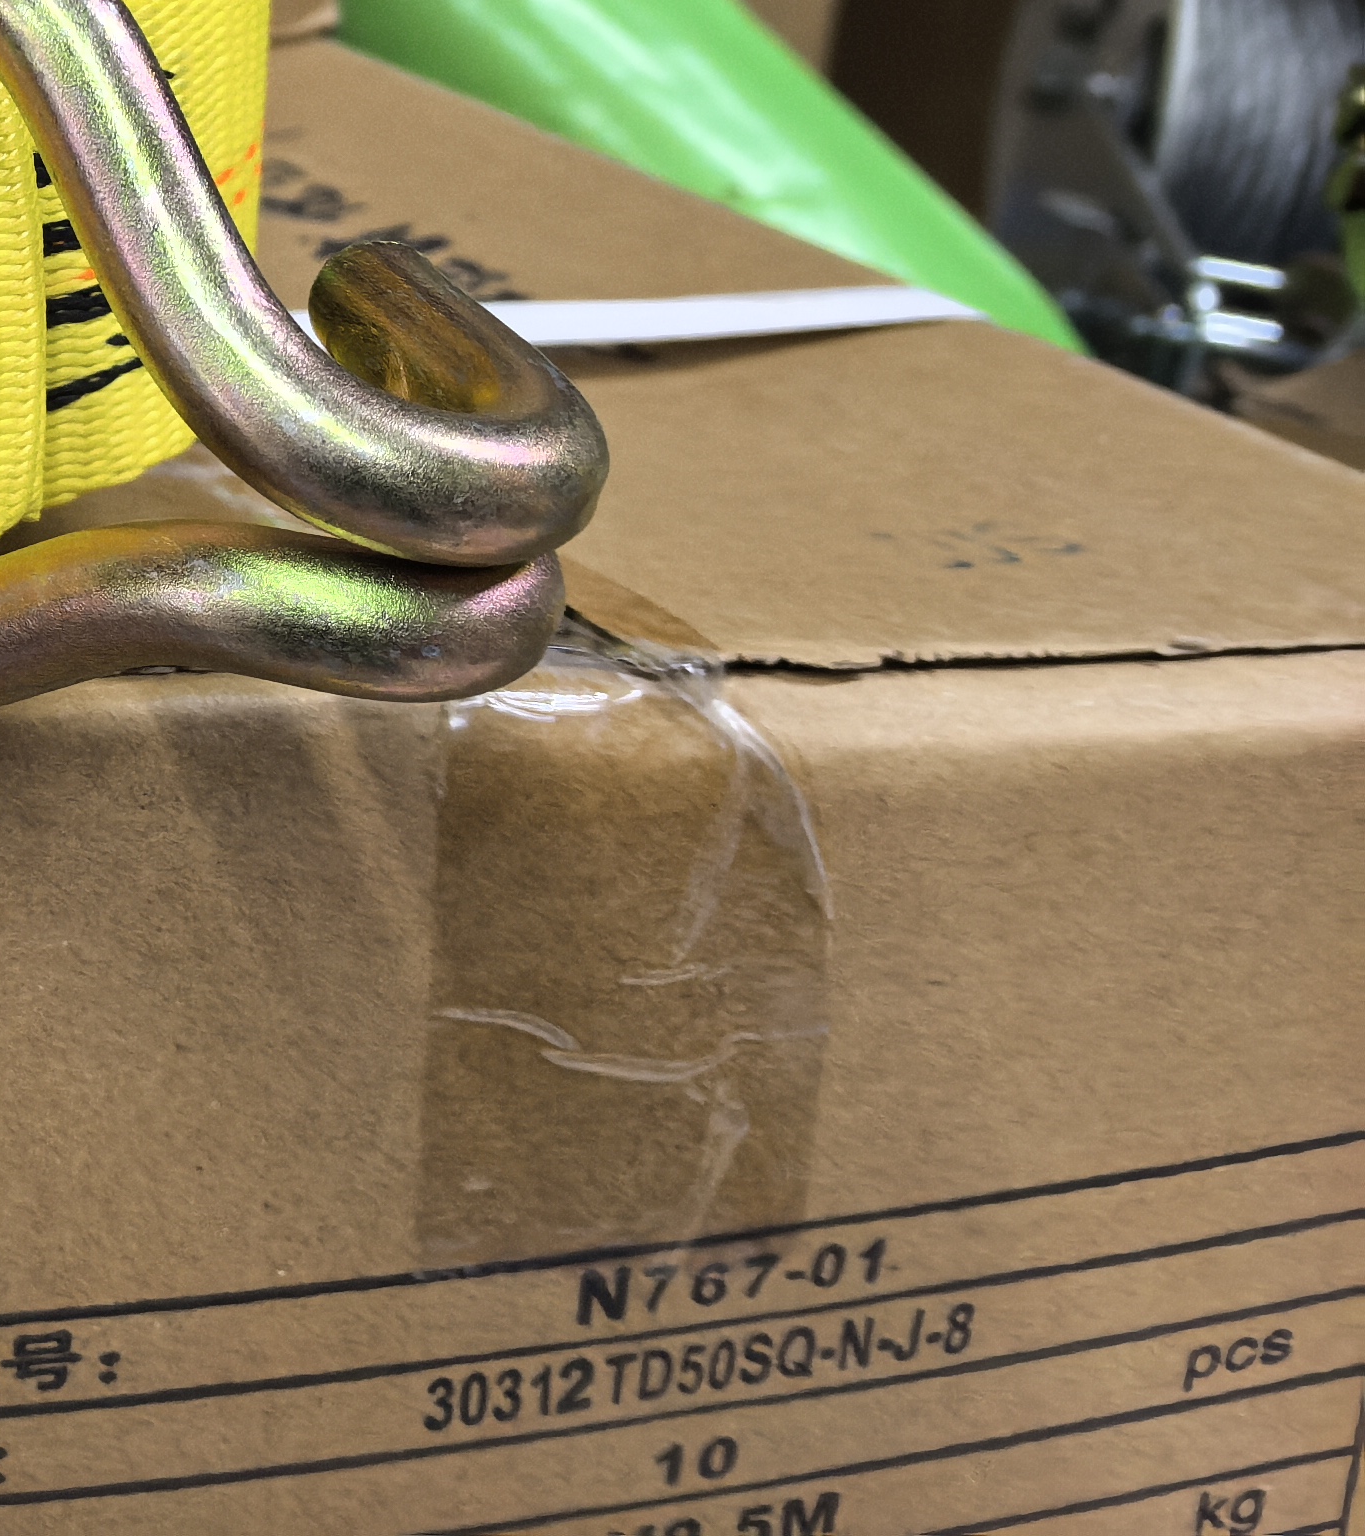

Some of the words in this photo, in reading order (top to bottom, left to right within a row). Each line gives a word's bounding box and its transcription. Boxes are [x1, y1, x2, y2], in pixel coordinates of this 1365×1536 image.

[576, 1236, 889, 1326] N767-01
[422, 1301, 976, 1431] 30312TD50SQ-N-J-8
[1183, 1327, 1295, 1394] pcs
[653, 1435, 740, 1486] 10
[1193, 1490, 1268, 1536] kg
